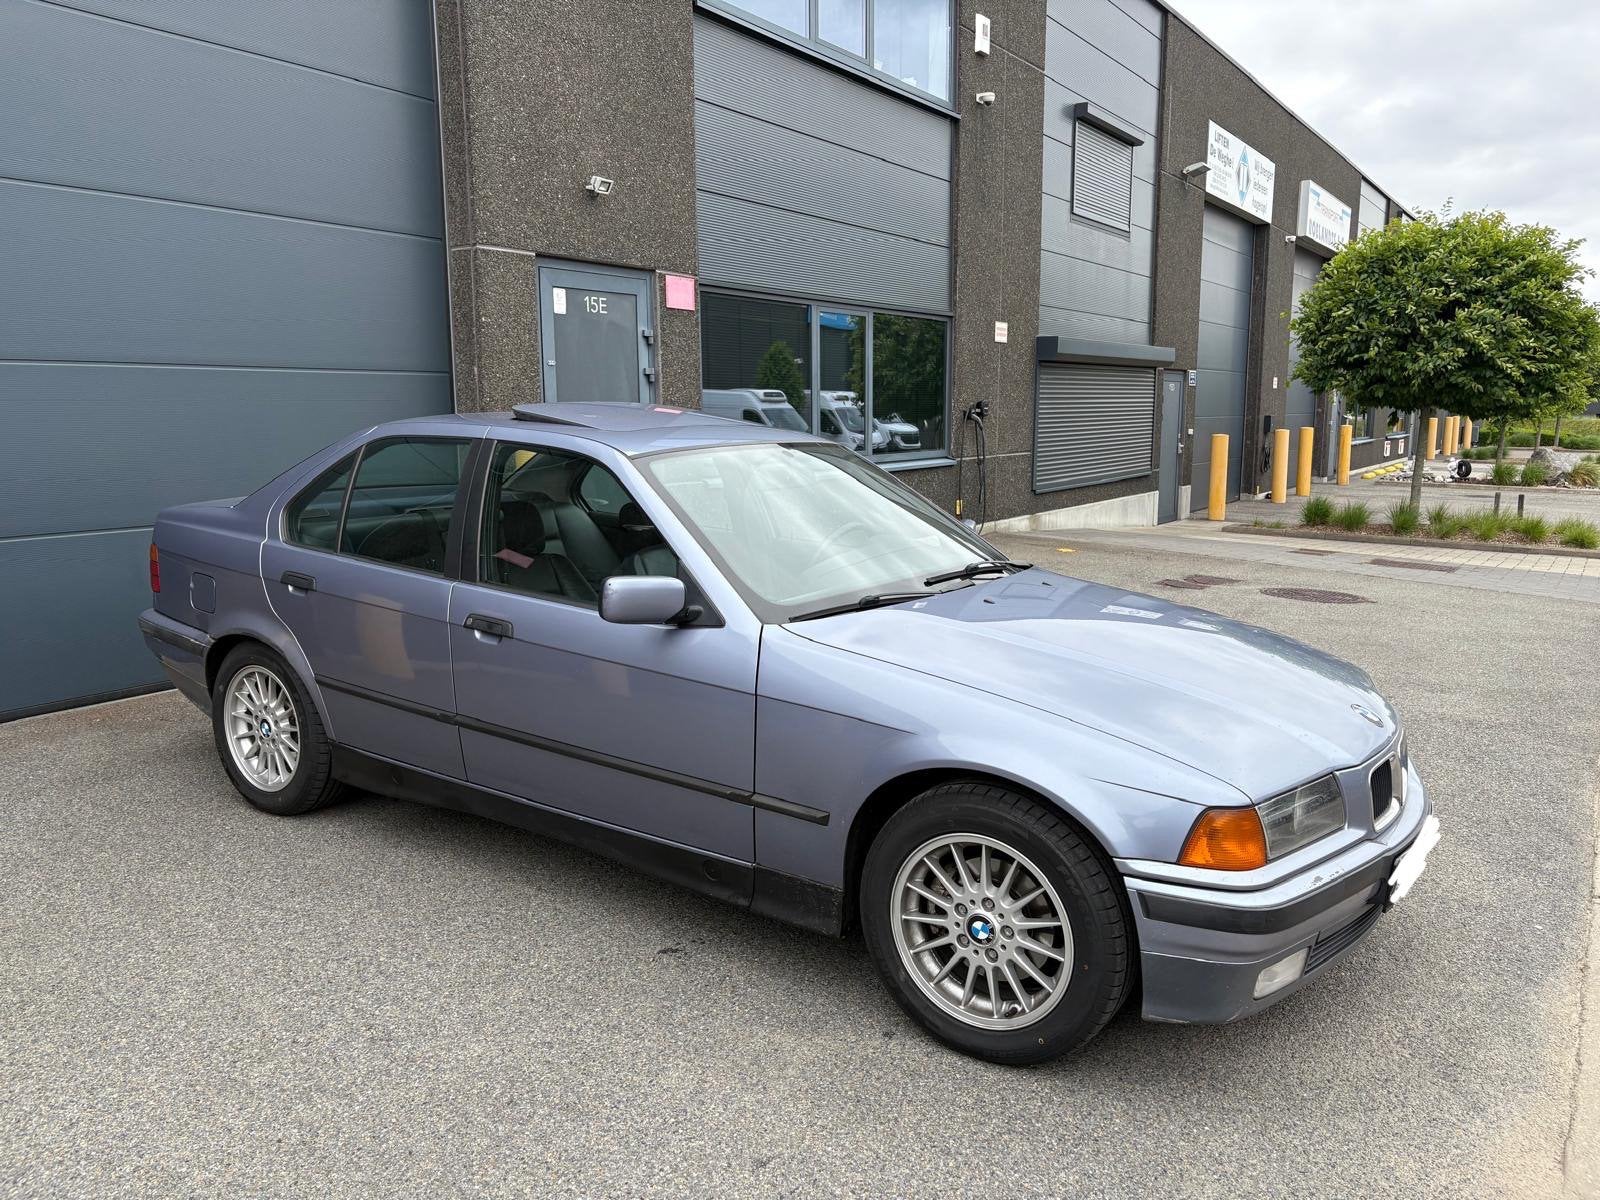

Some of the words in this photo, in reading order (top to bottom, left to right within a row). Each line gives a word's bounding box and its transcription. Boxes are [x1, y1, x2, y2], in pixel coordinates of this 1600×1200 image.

[1215, 130, 1230, 150] LIFTEN
[1209, 143, 1217, 158] De
[583, 295, 608, 314] 15E
